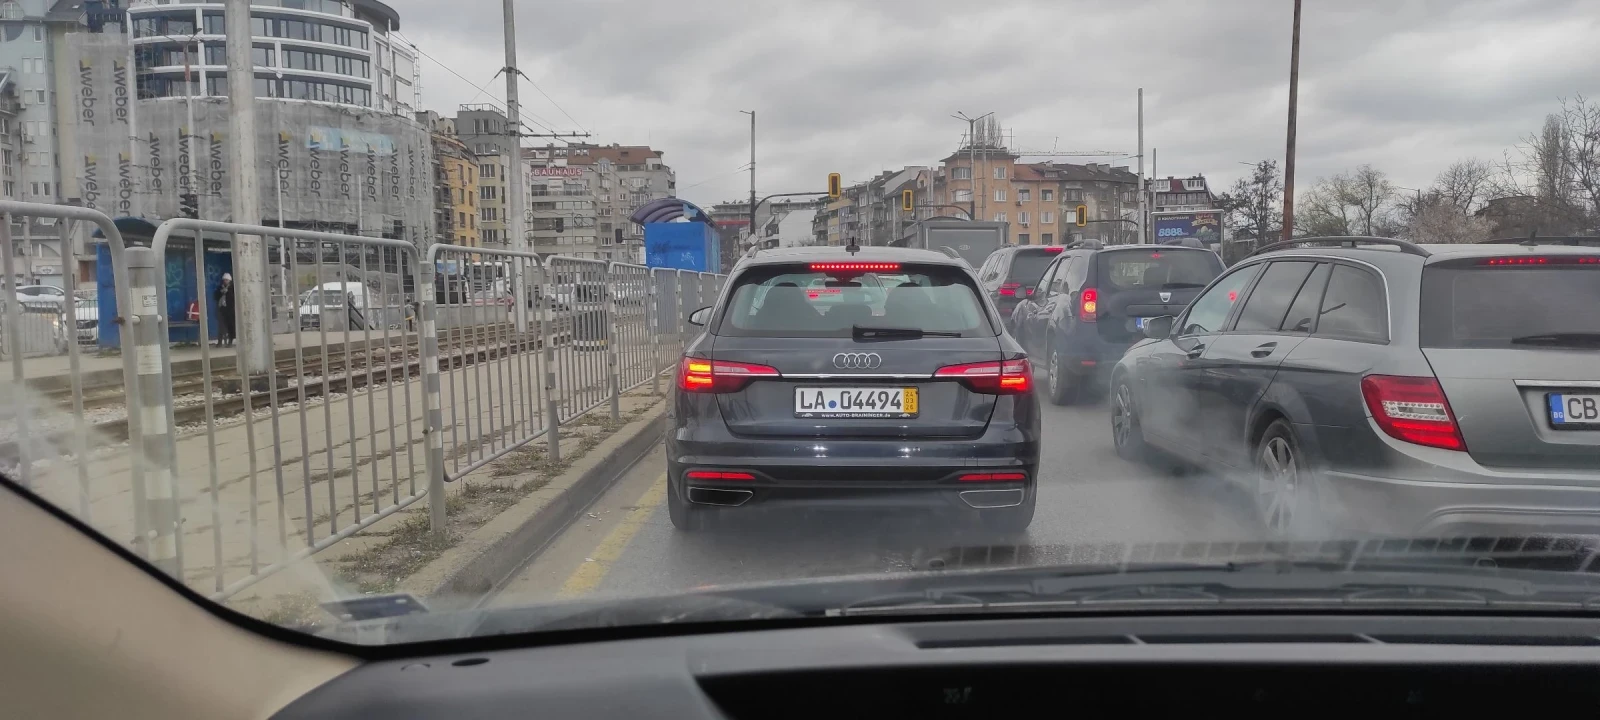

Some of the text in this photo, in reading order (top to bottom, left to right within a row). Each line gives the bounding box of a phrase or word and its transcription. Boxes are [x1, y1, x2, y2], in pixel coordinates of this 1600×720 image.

[80, 71, 97, 126] weber
[114, 71, 128, 125] weber
[84, 165, 100, 209] webe
[118, 162, 132, 217] weber
[150, 142, 163, 195] weber
[179, 139, 190, 194] weber
[211, 144, 225, 198] weber
[278, 143, 292, 197] weber
[310, 147, 322, 197] weber
[340, 148, 351, 200] weber
[367, 152, 377, 202] weber
[391, 152, 400, 200] weber
[408, 151, 416, 200] weber
[534, 168, 582, 176] BAUHAUS
[800, 390, 902, 410] LA 04494
[1553, 411, 1564, 419] BG
[1567, 397, 1599, 419] CB
